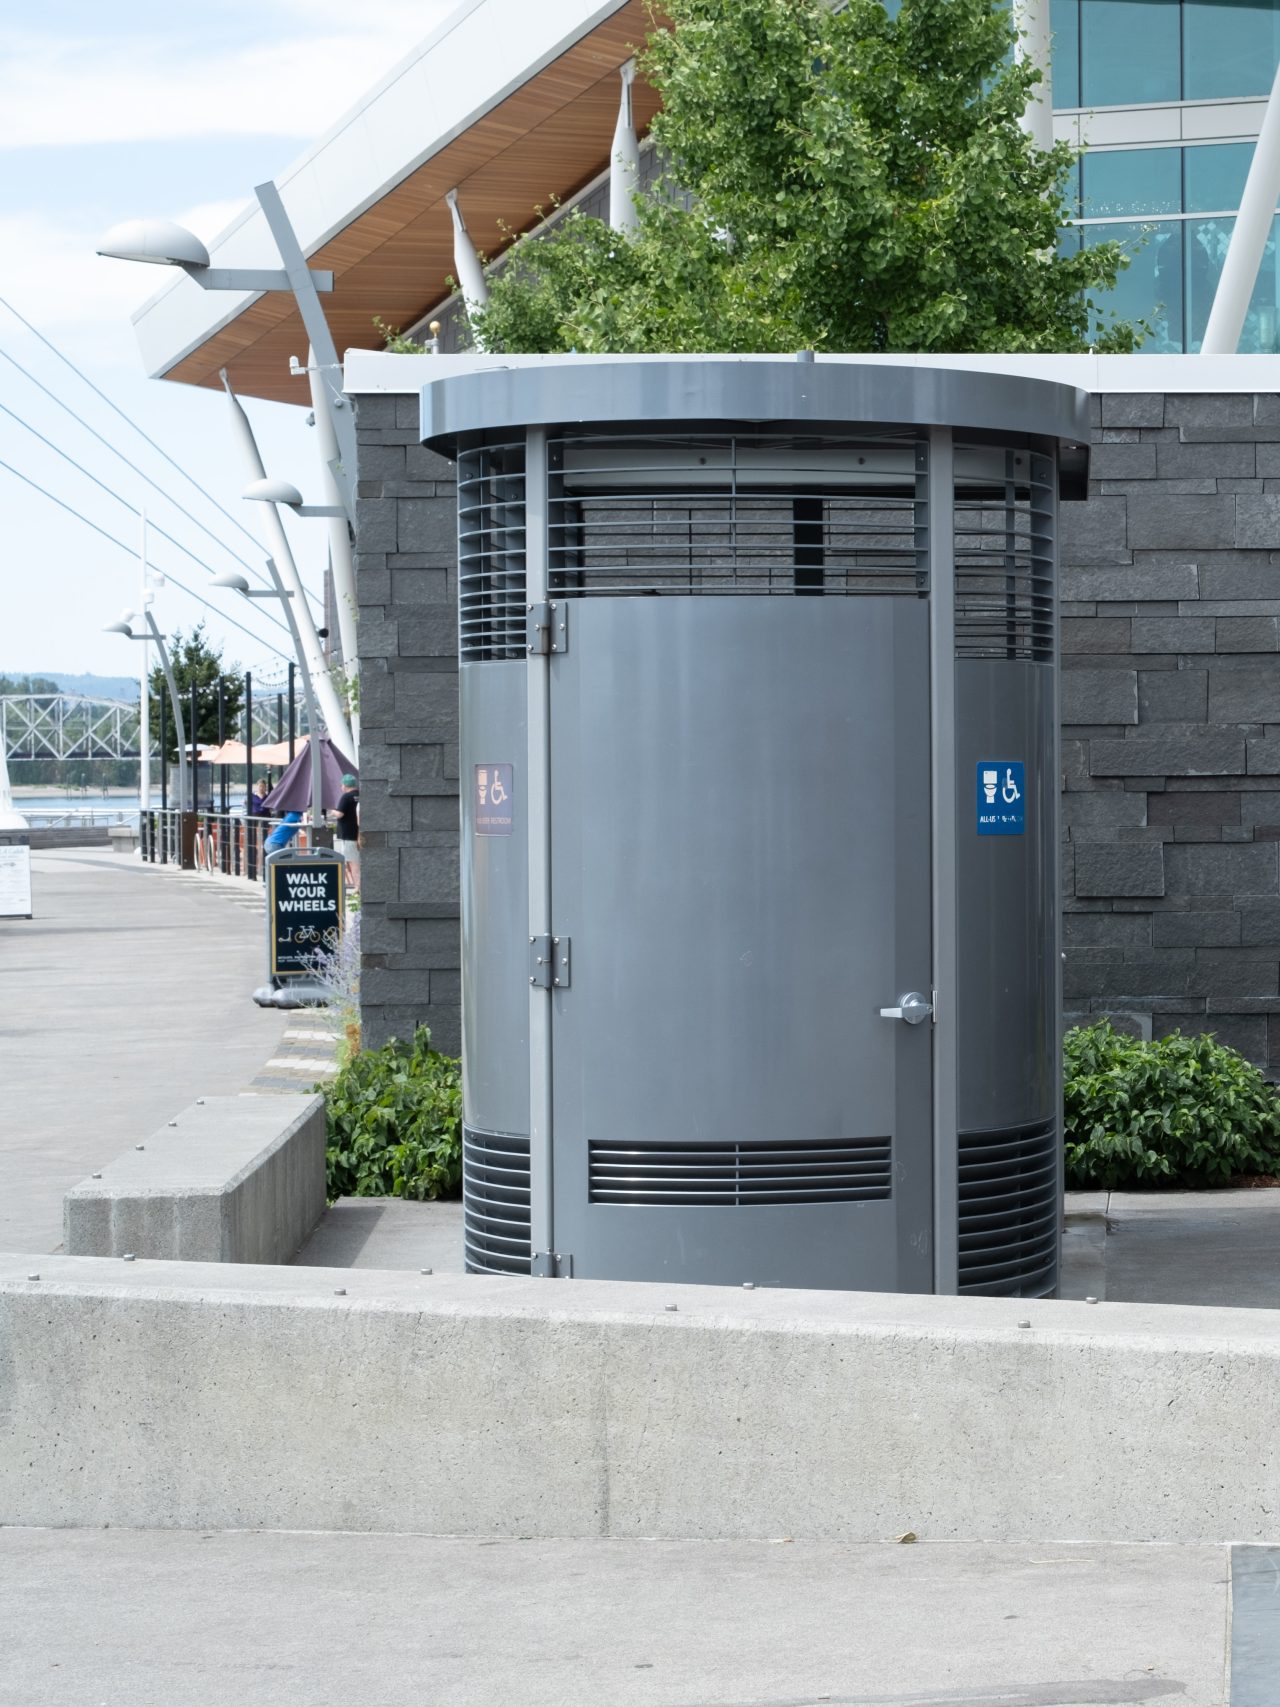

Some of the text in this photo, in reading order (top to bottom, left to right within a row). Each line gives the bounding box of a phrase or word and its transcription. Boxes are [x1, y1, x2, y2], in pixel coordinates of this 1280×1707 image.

[286, 873, 328, 885] WALK
[288, 886, 326, 898] YOUR
[278, 900, 336, 912] WHEELS
